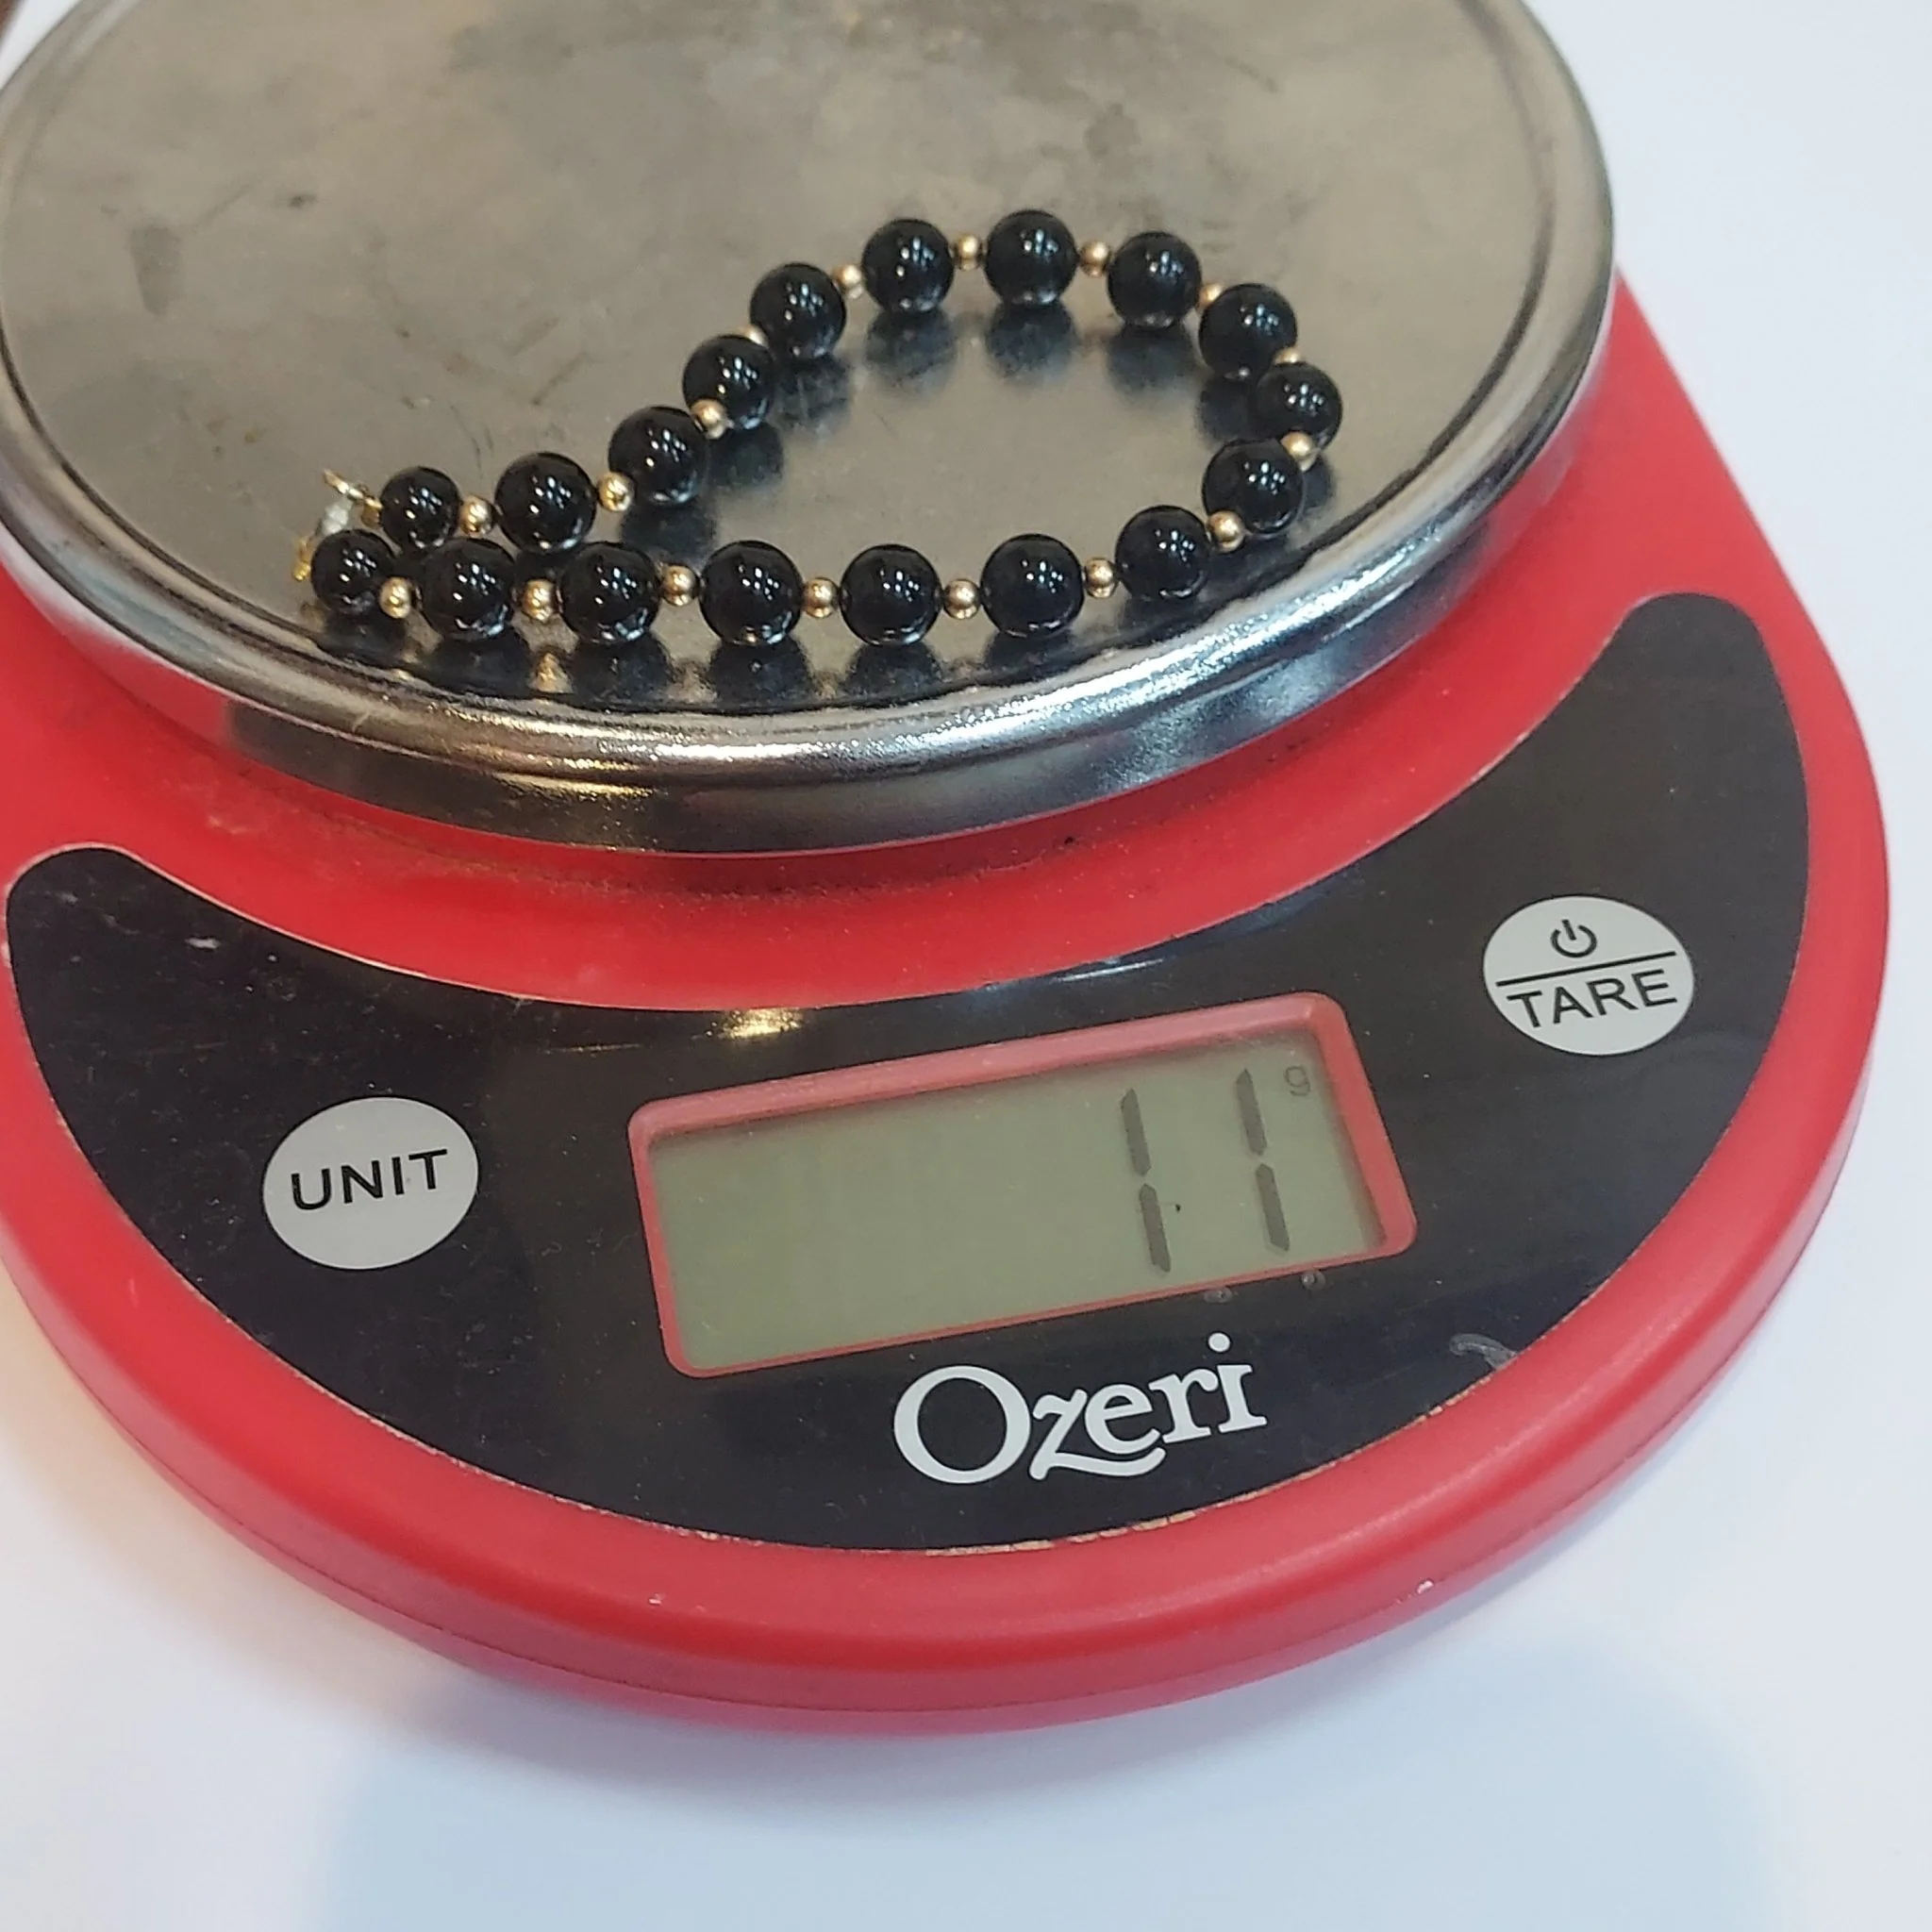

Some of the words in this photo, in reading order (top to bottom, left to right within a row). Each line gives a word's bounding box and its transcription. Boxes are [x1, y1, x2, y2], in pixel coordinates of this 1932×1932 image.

[1507, 968, 1678, 1027] TARE
[291, 1148, 448, 1210] UNIT
[1120, 1068, 1290, 1273] 11
[1284, 1065, 1311, 1097] g
[893, 1332, 1268, 1485] Ozeri
